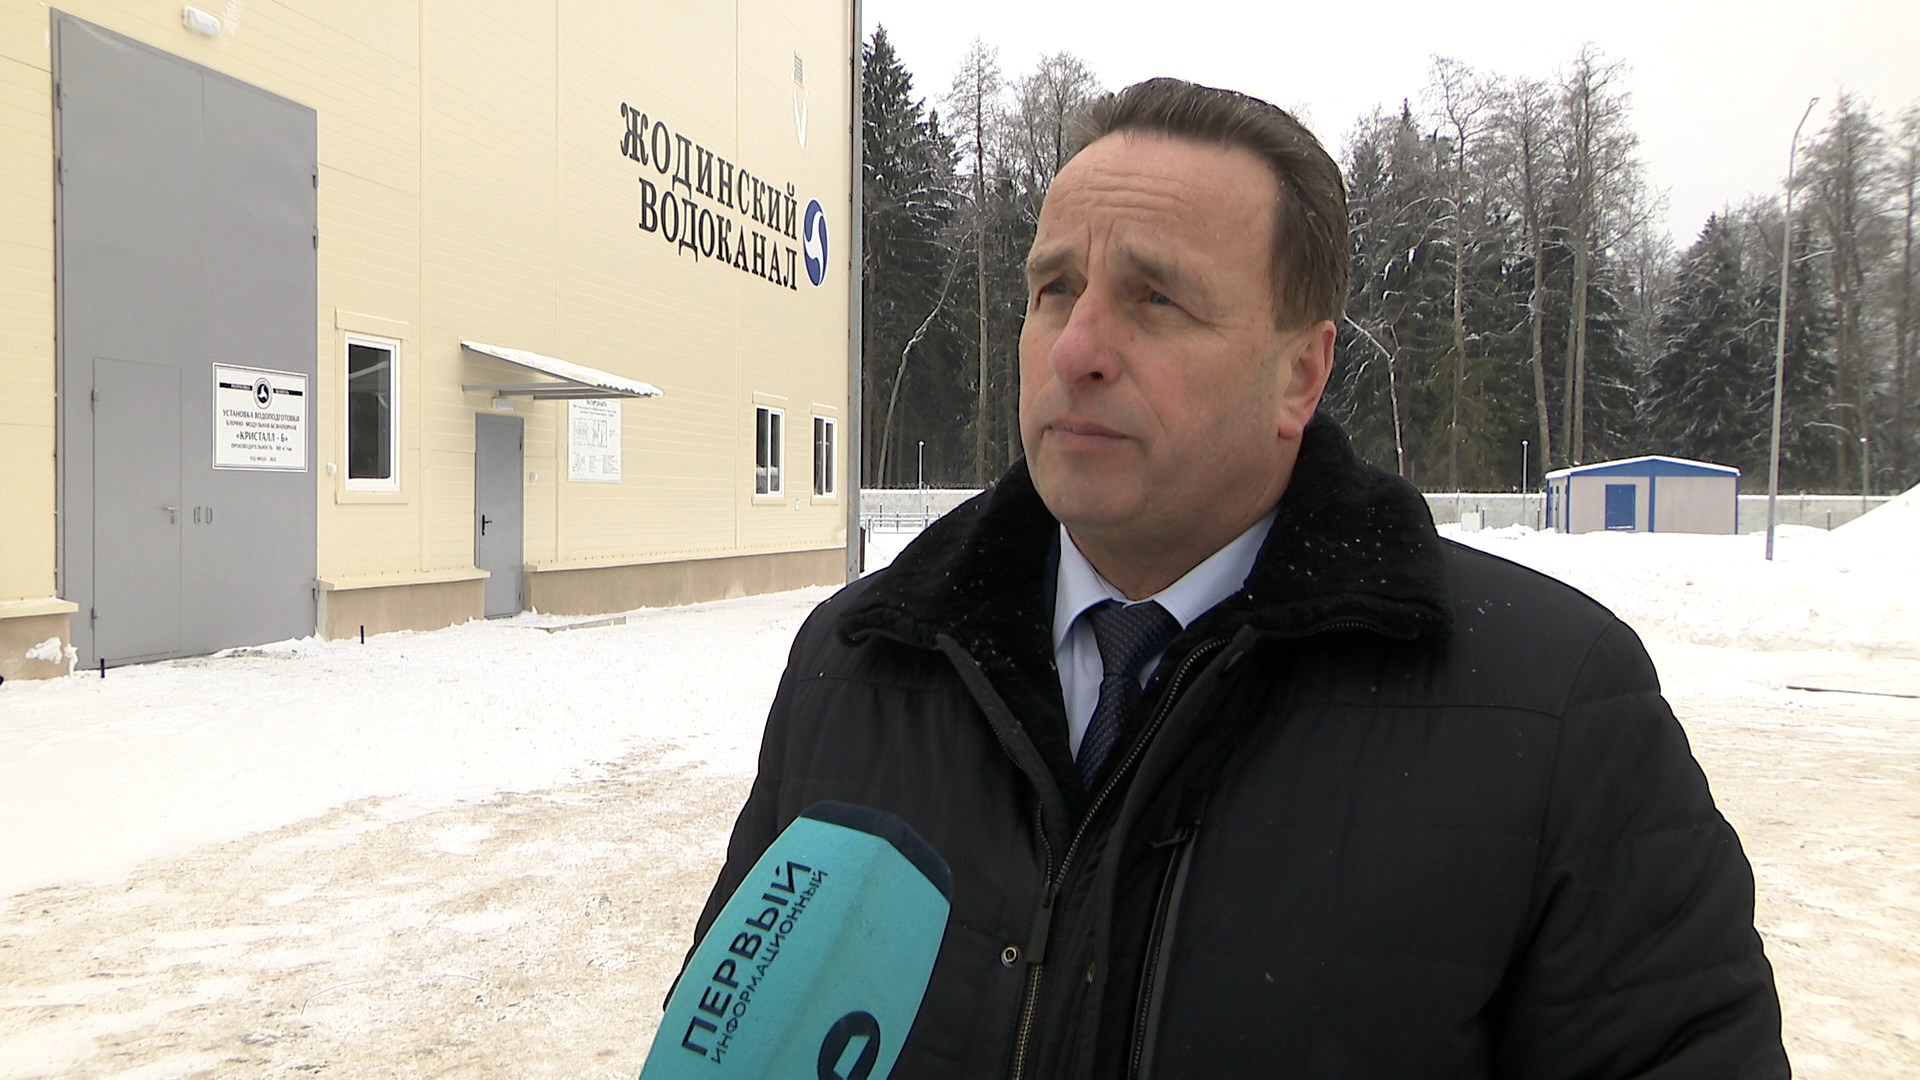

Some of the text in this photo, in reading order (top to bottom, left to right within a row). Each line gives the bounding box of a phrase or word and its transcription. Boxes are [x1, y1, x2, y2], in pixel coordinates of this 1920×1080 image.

[620, 102, 798, 241] ЖОДИНСКИЙ
[638, 177, 798, 291] ВОДОКАНАЛ
[222, 409, 300, 422] УСТАНОВКА ВОДОПОДГОТОВКИ
[681, 860, 813, 1057] ПЕРВЫЙ
[711, 869, 829, 1065] ИНФОРМАЦИОННЫЙ
